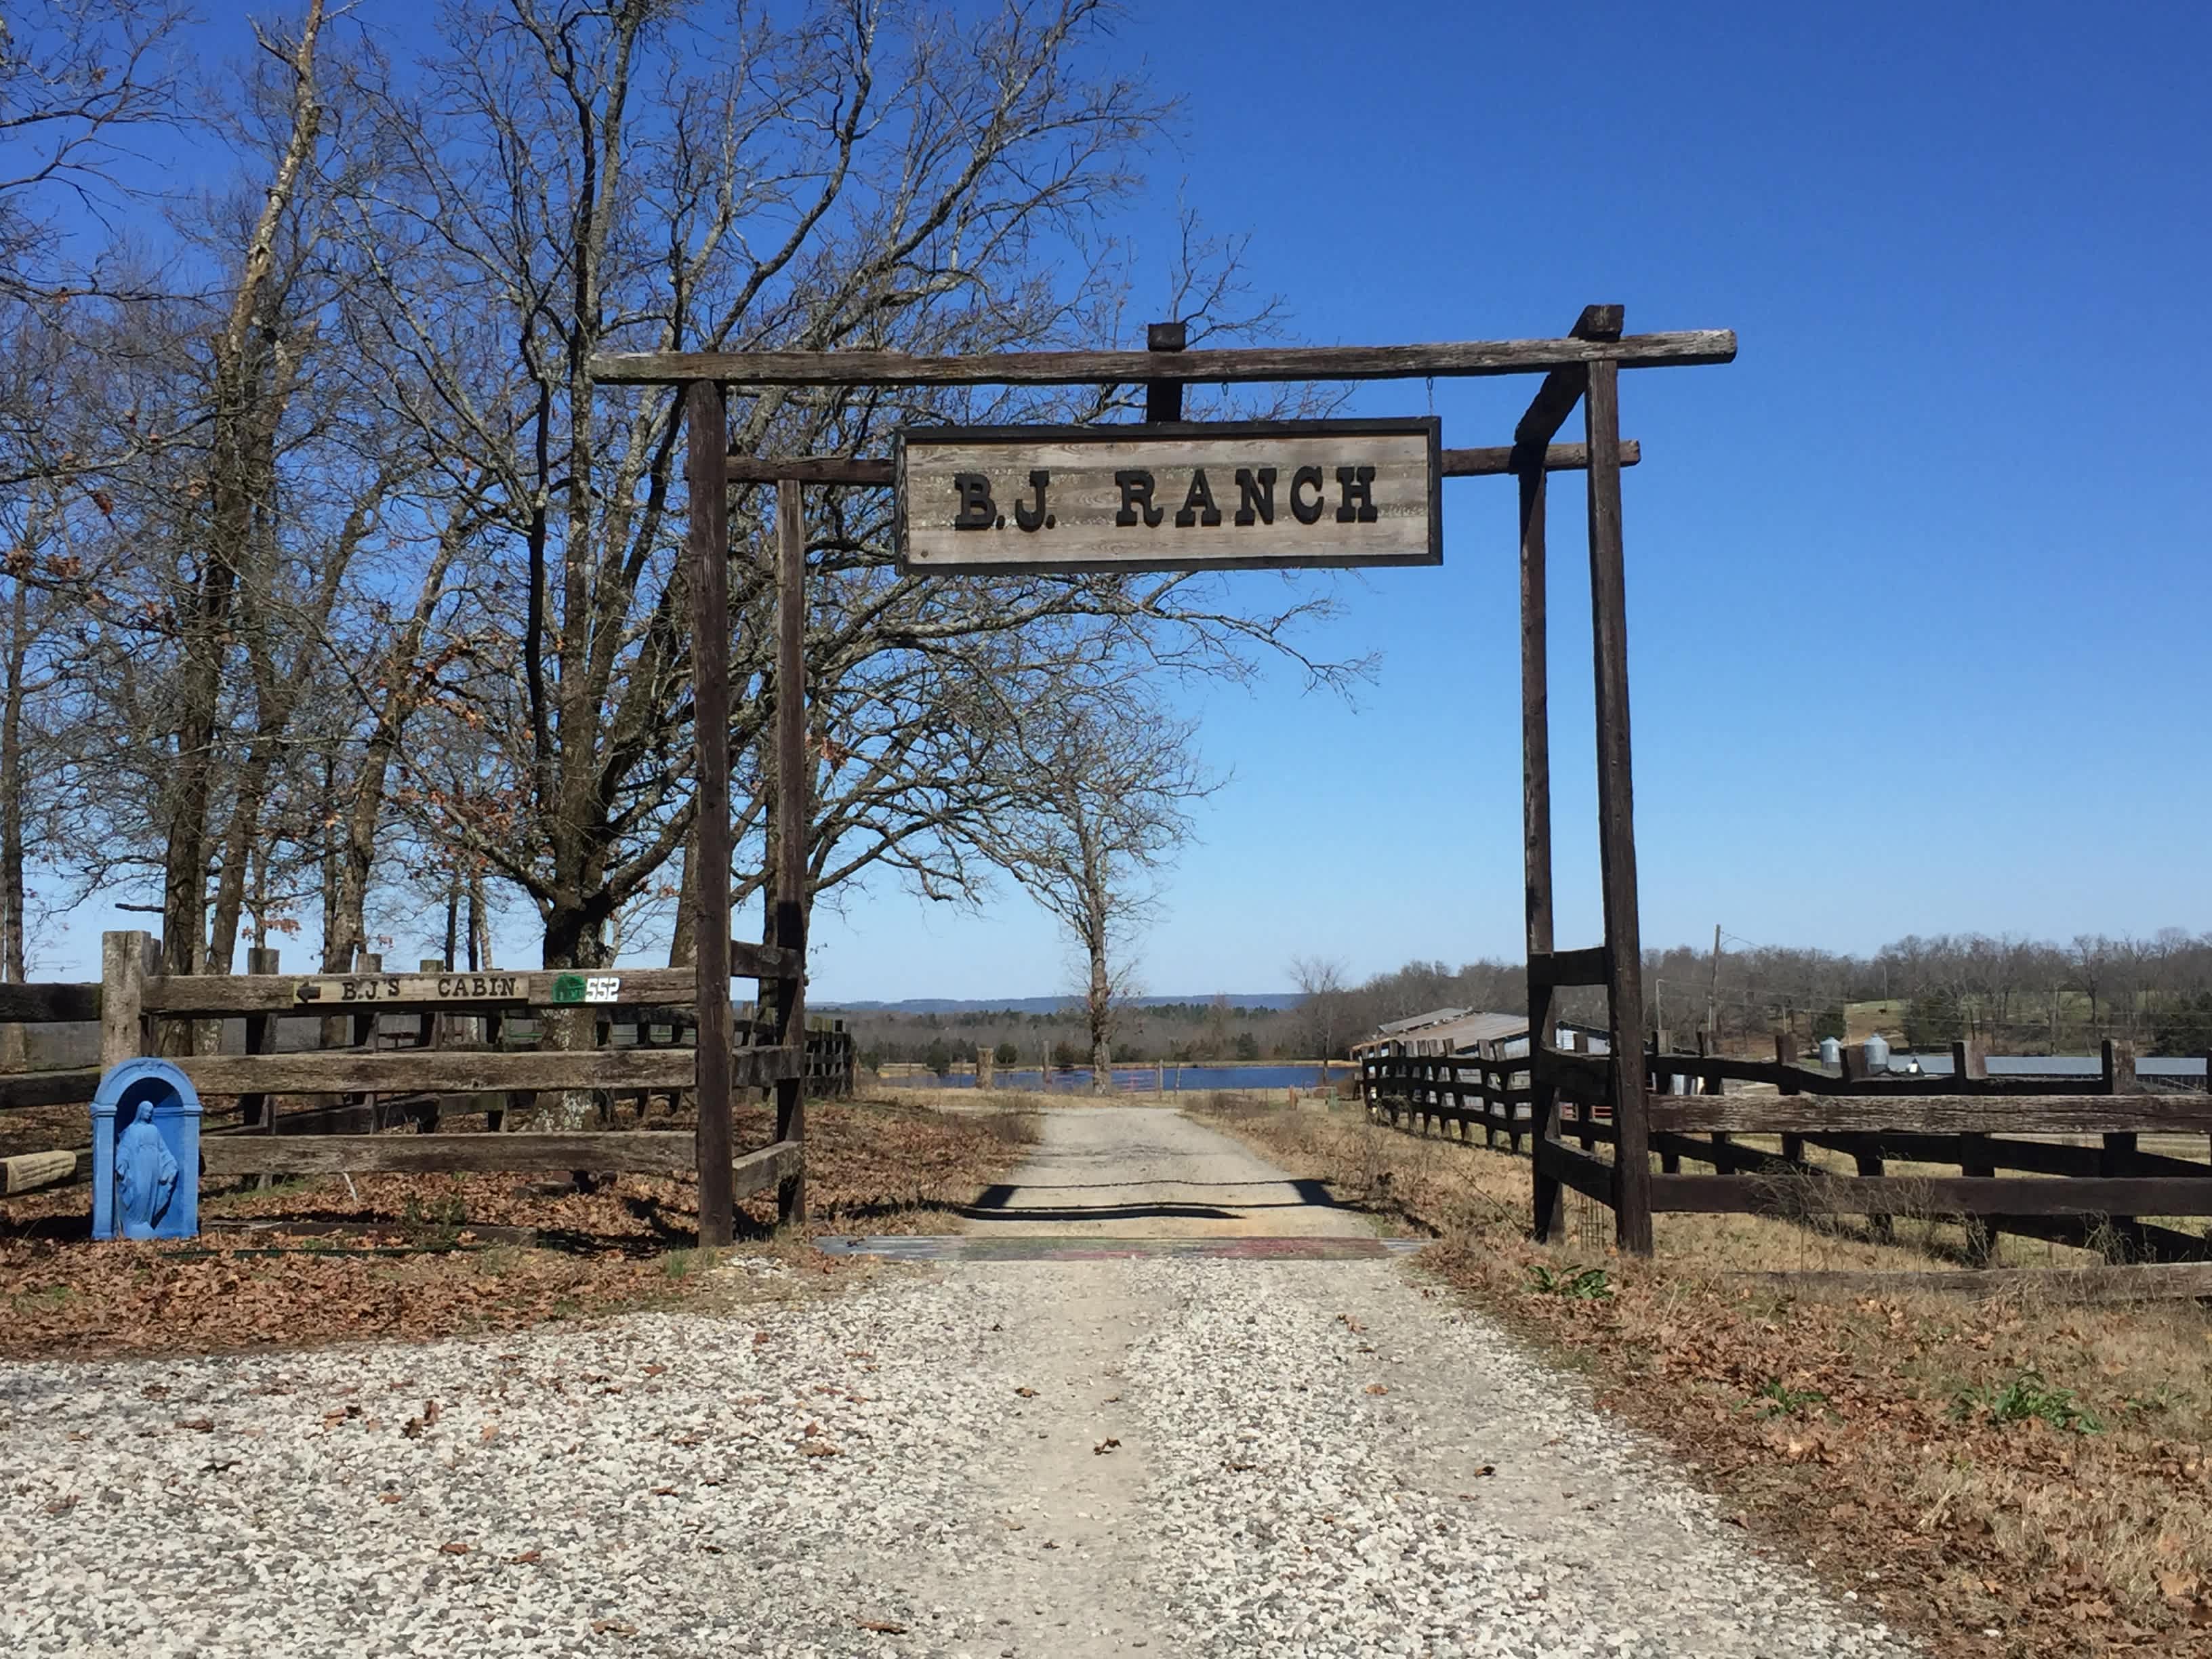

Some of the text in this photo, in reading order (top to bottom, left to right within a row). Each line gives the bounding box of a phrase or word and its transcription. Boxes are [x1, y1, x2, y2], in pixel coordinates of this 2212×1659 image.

[954, 466, 1378, 533] B.J. RANCH
[438, 978, 516, 998] CABIN
[585, 977, 620, 1002] 552
